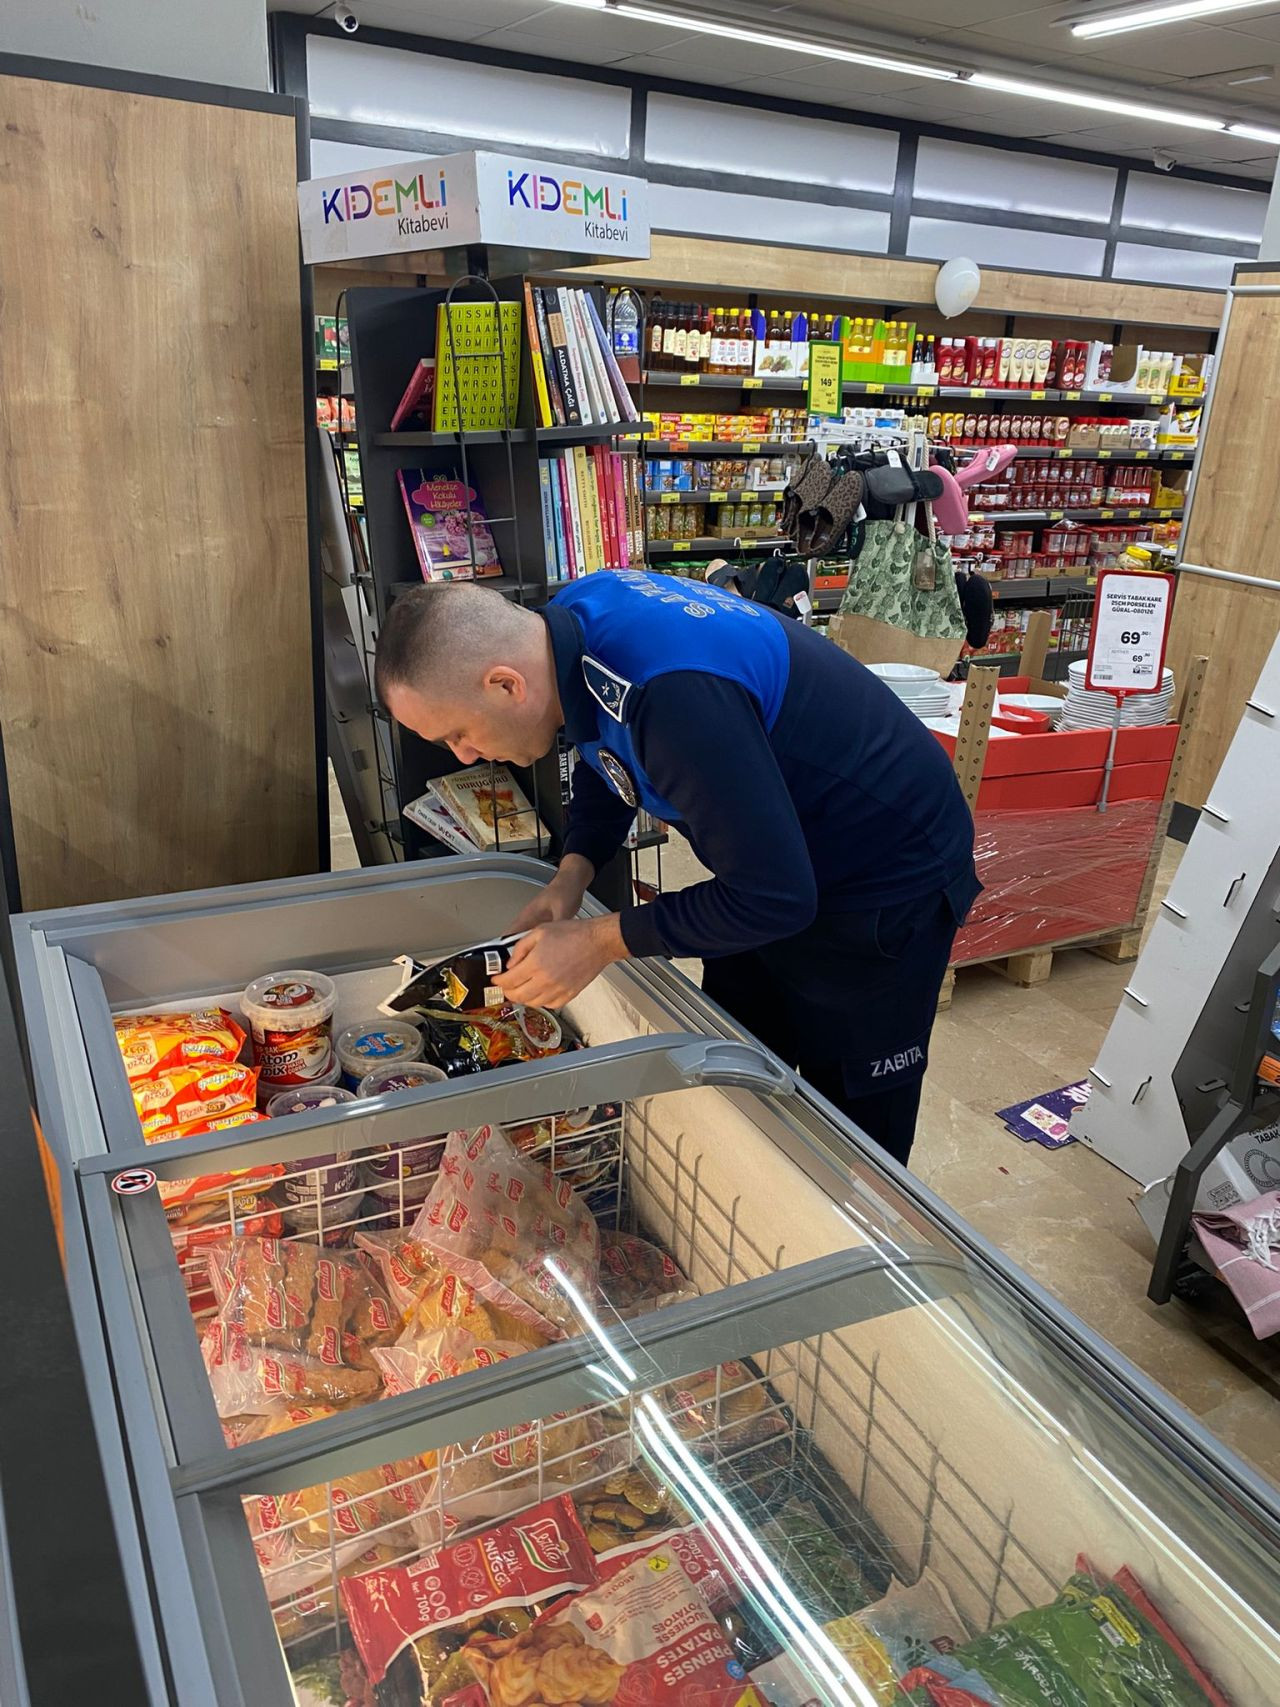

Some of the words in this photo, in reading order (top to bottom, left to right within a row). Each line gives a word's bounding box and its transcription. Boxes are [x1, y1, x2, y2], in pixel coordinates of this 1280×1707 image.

[398, 212, 449, 236] Kitabevi
[584, 221, 628, 242] Kitabevi
[557, 349, 571, 388] ALDATMA
[564, 386, 575, 408] ÇAĞI
[1120, 631, 1140, 645] 69
[1132, 655, 1143, 663] 69
[260, 1051, 299, 1065] Atom
[870, 1046, 924, 1078] ZABITA
[530, 1523, 563, 1564] Lezita
[416, 1594, 431, 1623] 700g
[651, 1603, 704, 1634] POTATOES
[655, 1612, 710, 1644] DUCHESSE
[655, 1624, 723, 1670] PATATES
[663, 1641, 734, 1687] PRENSES
[1014, 1649, 1055, 1697] Fasulye
